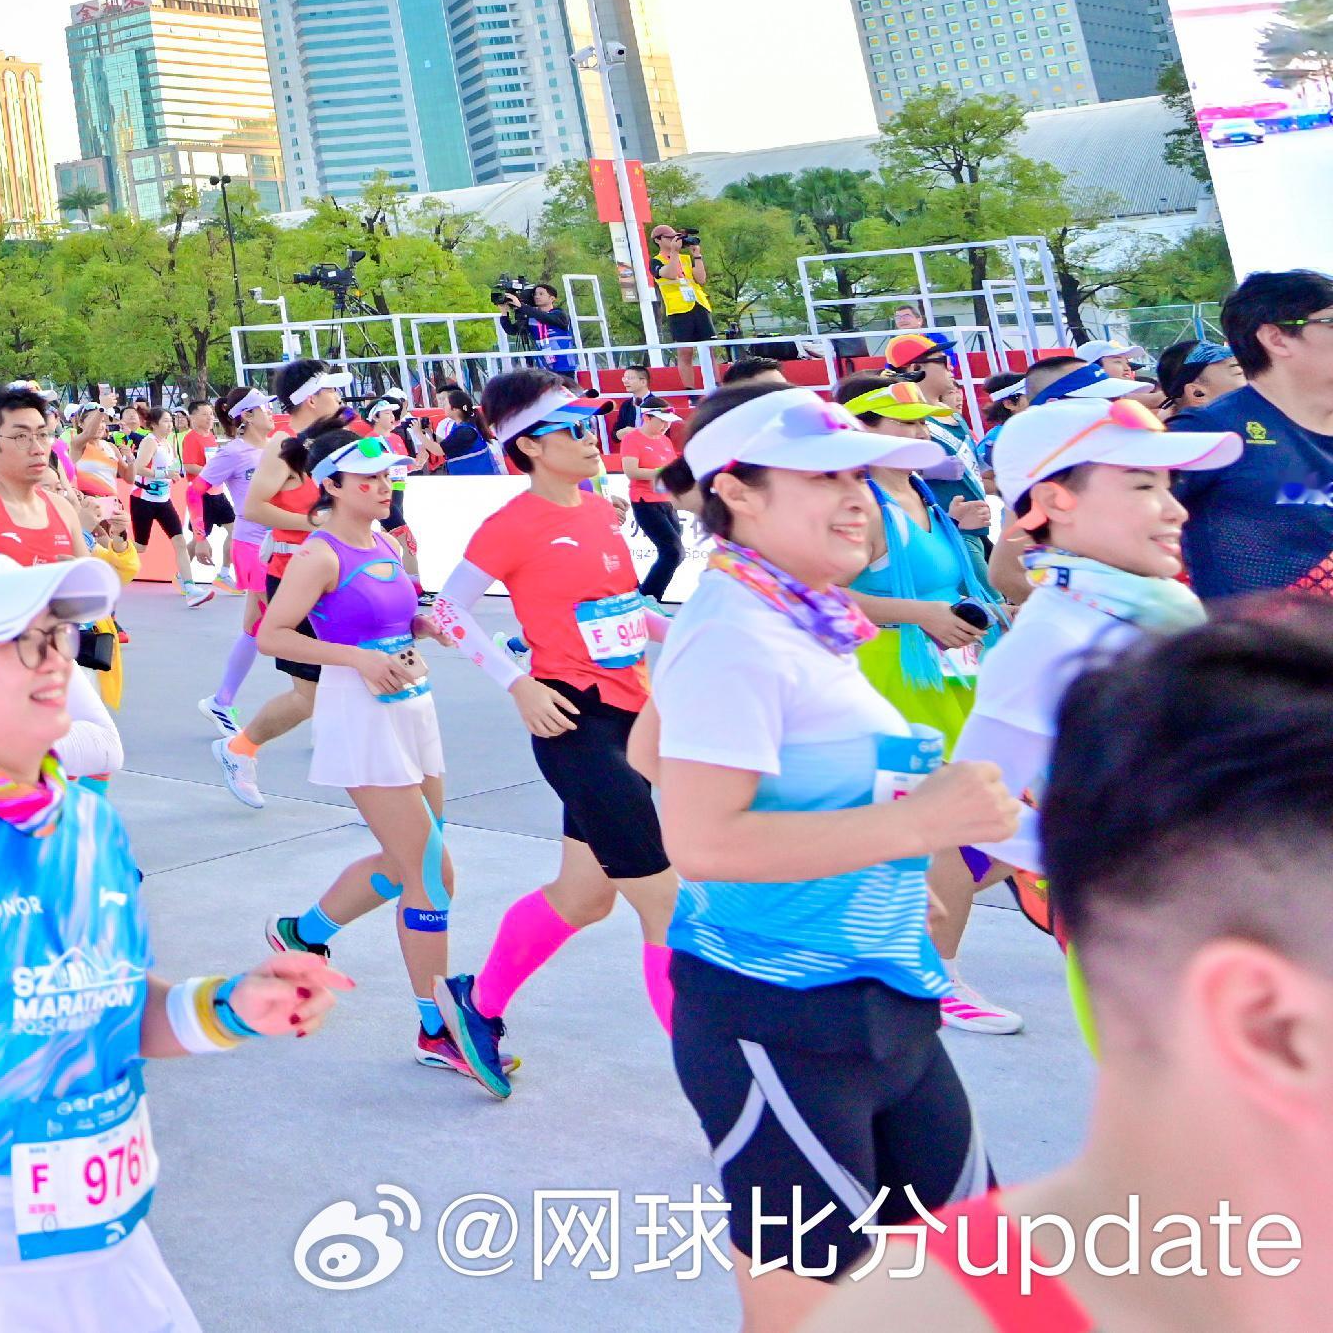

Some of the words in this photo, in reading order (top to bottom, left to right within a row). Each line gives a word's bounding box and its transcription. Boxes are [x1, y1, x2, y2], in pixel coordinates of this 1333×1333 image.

[592, 629, 603, 644] F
[13, 984, 136, 1020] MARATHON
[31, 1164, 50, 1194] F
[84, 1124, 150, 1207] 9761
